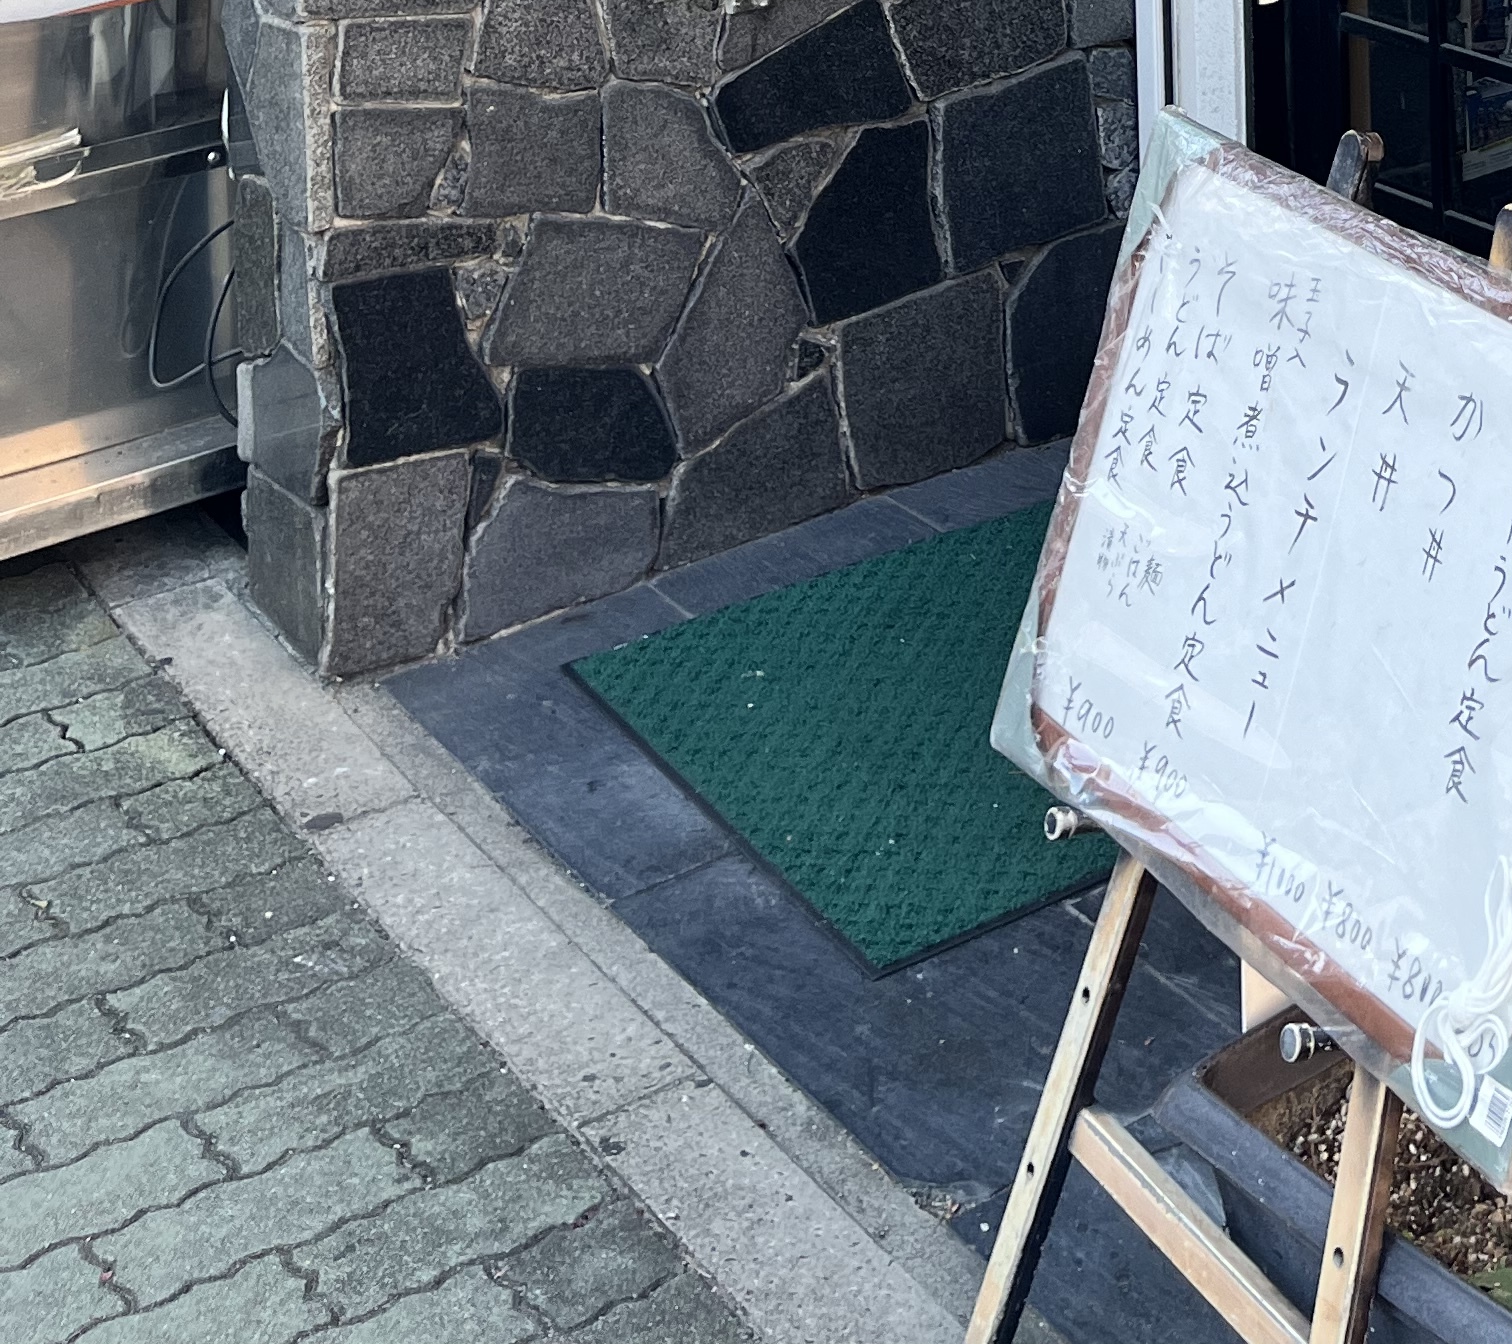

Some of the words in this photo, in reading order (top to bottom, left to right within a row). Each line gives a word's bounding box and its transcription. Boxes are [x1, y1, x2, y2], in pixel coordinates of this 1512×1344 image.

[1138, 247, 1201, 472] うどん定食
[1168, 251, 1239, 496] そば定食
[1371, 359, 1416, 512] 天丼
[1164, 272, 1297, 739] 味噌煮込うどん定食
[1243, 349, 1356, 739] ランチメニュー
[1421, 392, 1484, 583] かつ丼
[1062, 676, 1115, 739] ¥900
[1138, 740, 1188, 799] ¥900
[1322, 879, 1373, 950] ¥800
